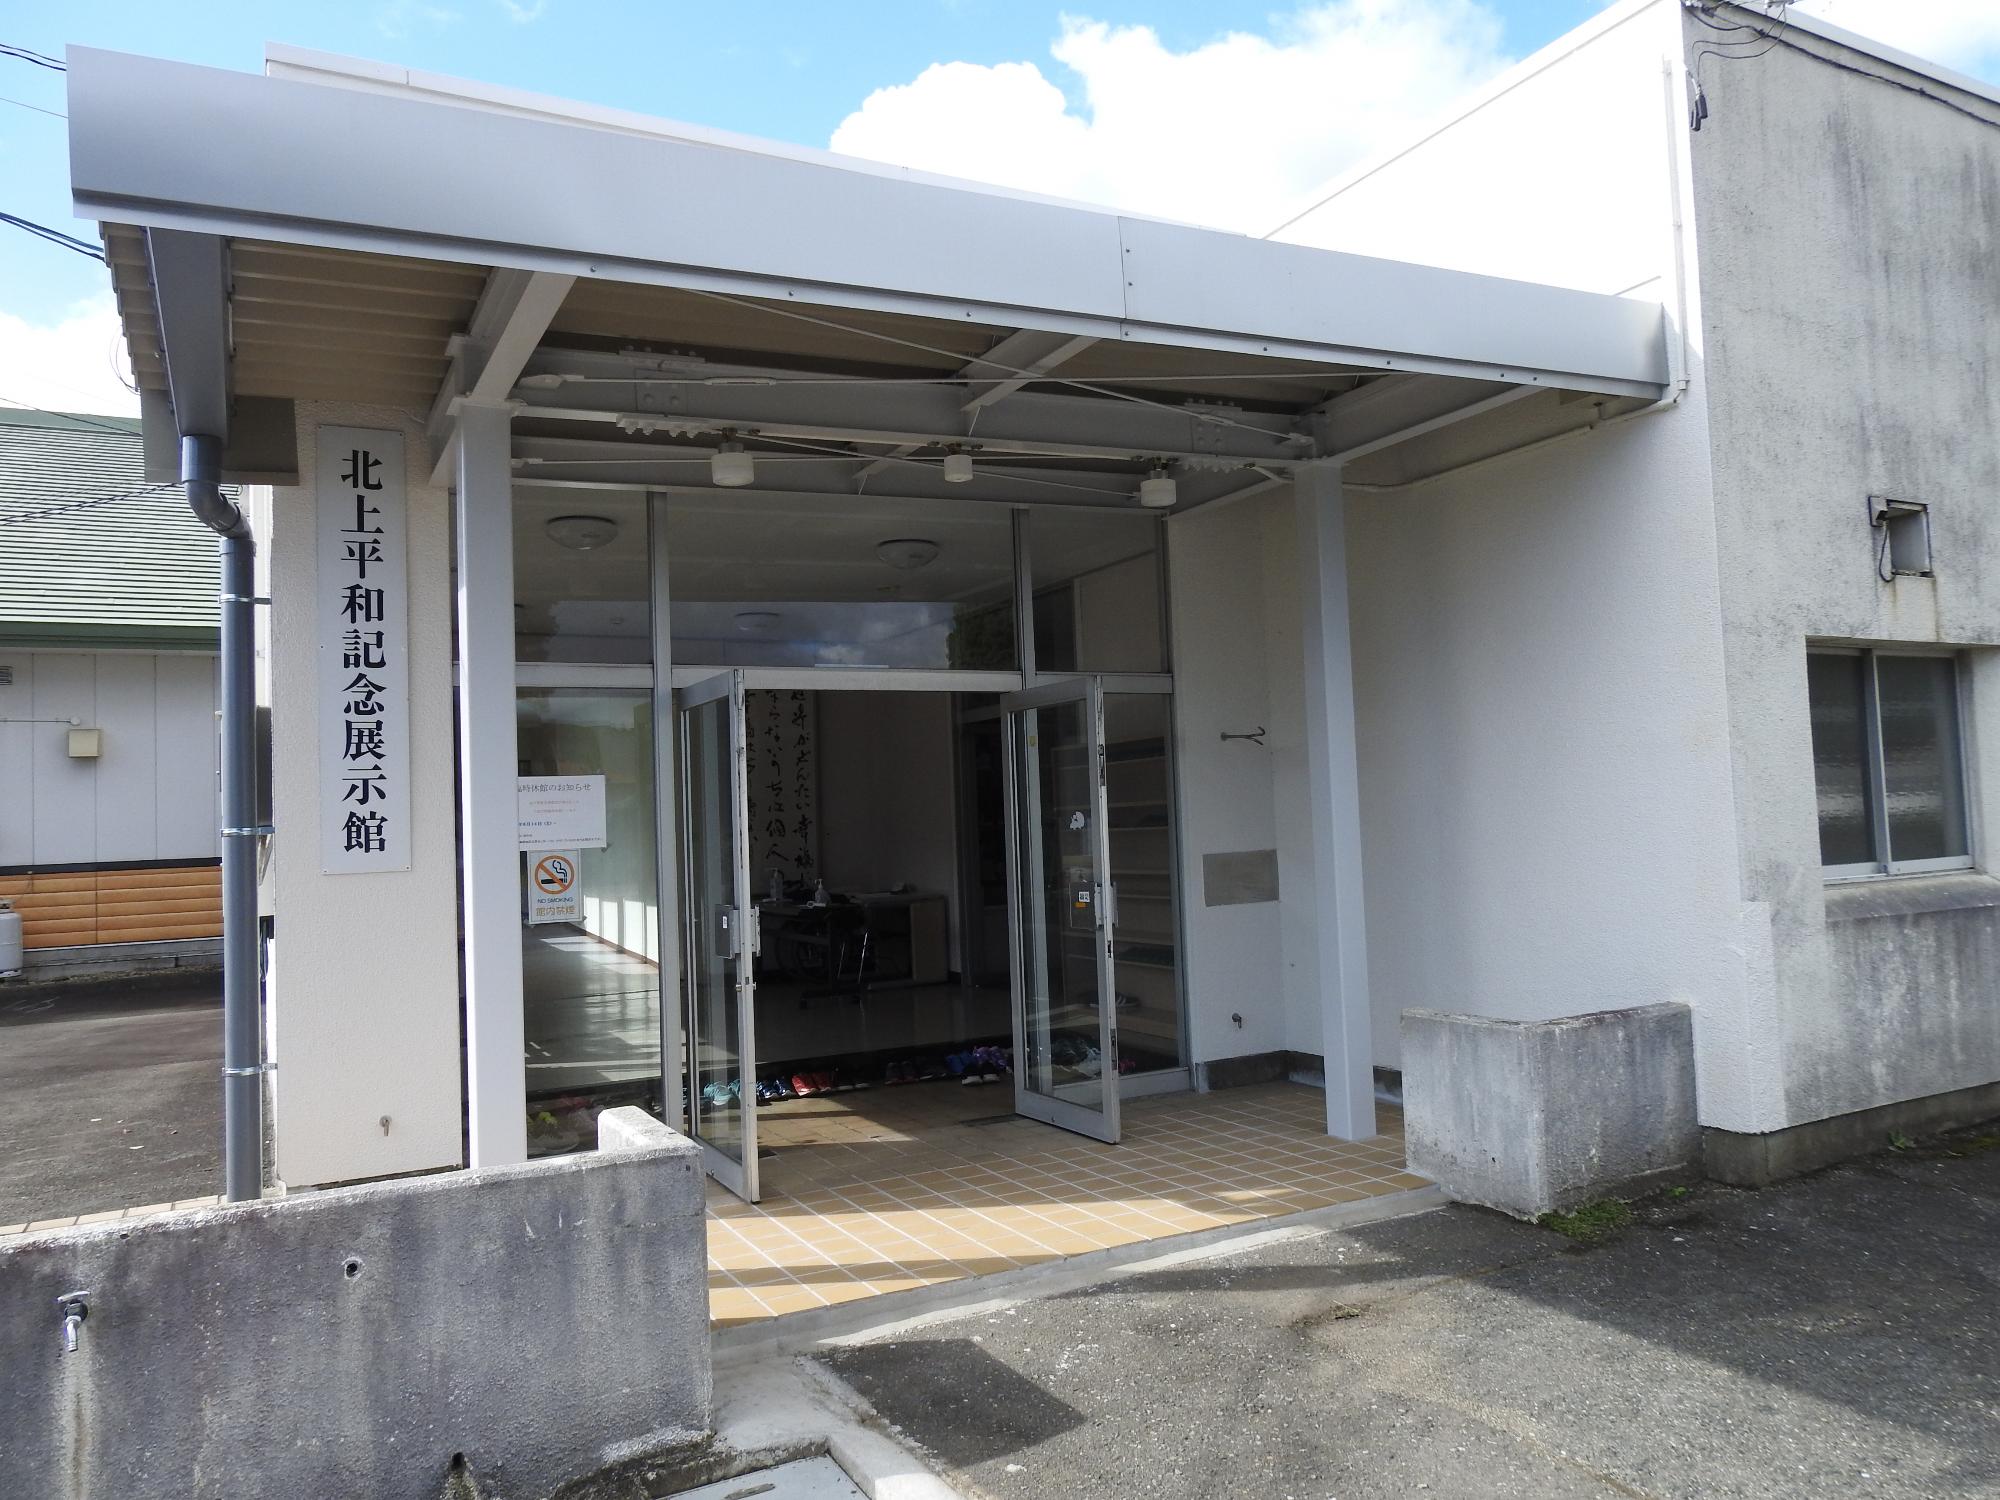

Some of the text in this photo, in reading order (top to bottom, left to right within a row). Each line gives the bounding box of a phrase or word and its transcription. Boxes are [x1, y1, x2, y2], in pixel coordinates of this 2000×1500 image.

[340, 449, 388, 854] 北上平和記念展示館
[547, 896, 574, 904] SMOKING
